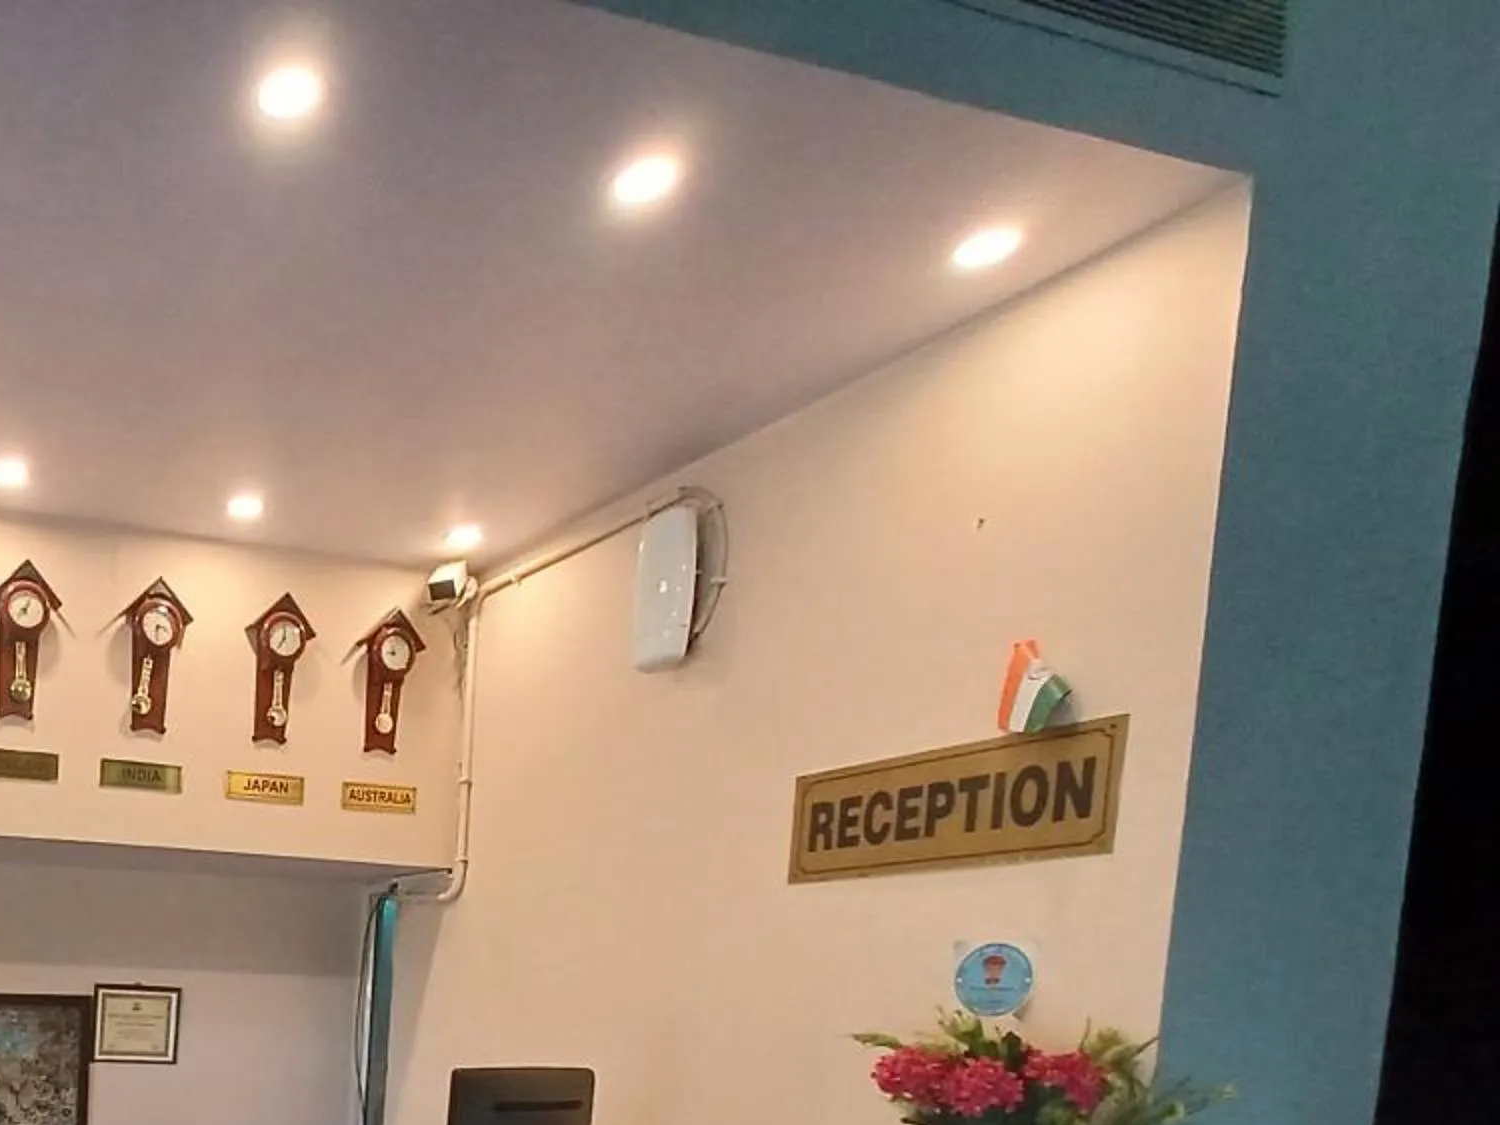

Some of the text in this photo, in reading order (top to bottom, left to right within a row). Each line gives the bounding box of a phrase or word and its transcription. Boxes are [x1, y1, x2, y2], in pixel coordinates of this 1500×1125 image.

[120, 766, 162, 782] INDIA
[243, 777, 290, 794] JAPAN
[348, 787, 412, 805] AUSTRALIA
[807, 755, 1097, 852] RECEPTION
